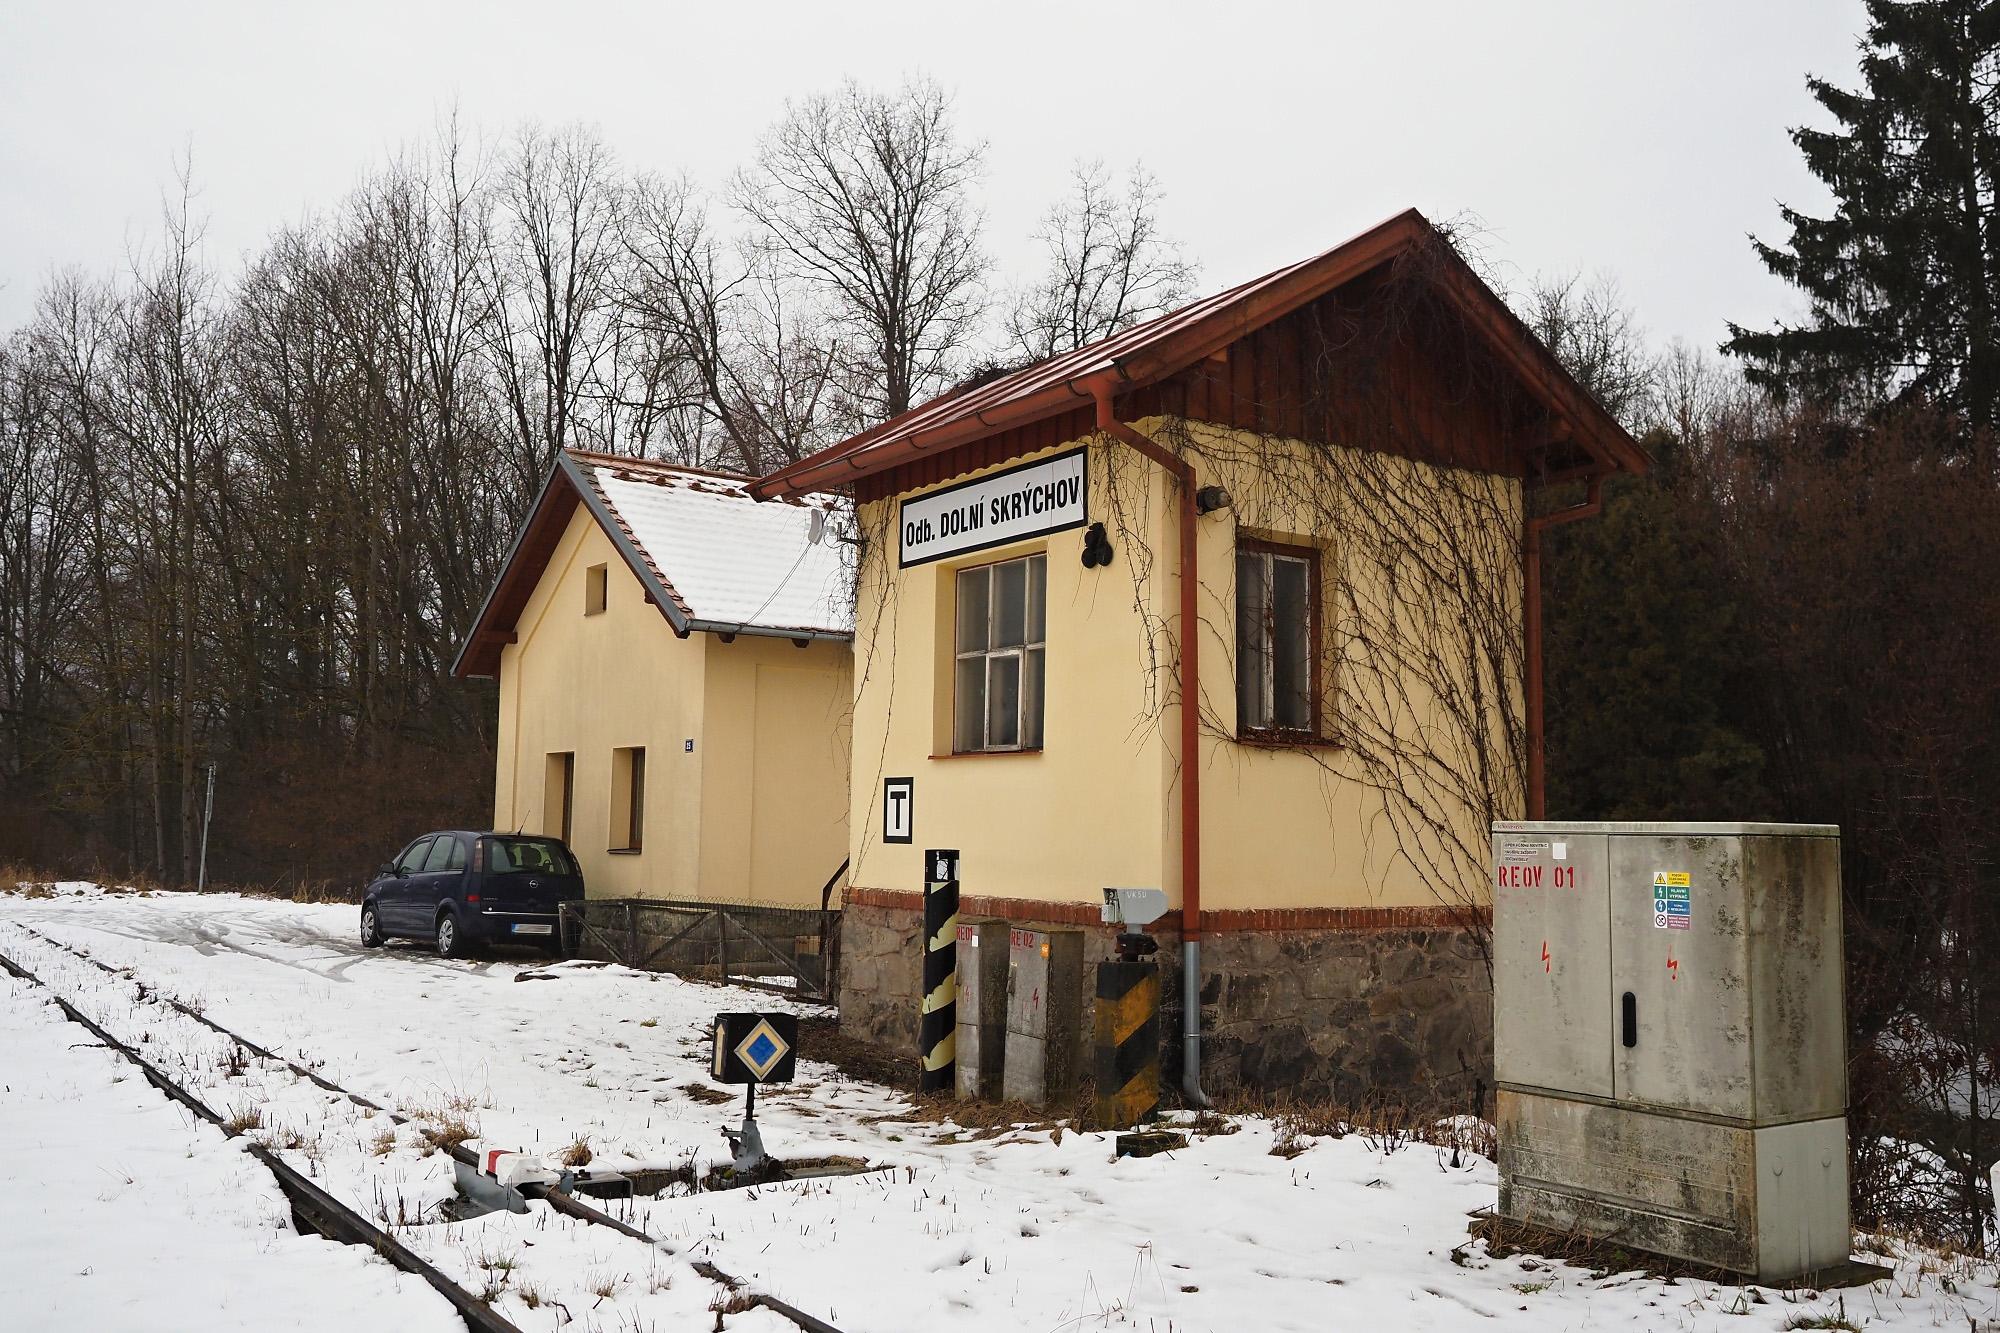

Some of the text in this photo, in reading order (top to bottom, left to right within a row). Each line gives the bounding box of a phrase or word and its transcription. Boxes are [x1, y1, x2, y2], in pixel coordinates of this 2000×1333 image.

[905, 475, 1080, 547] Odb. DOLNÍ SKRÝCHOV
[890, 791, 906, 829] T
[1554, 866, 1574, 888] 01
[1023, 931, 1034, 949] 02
